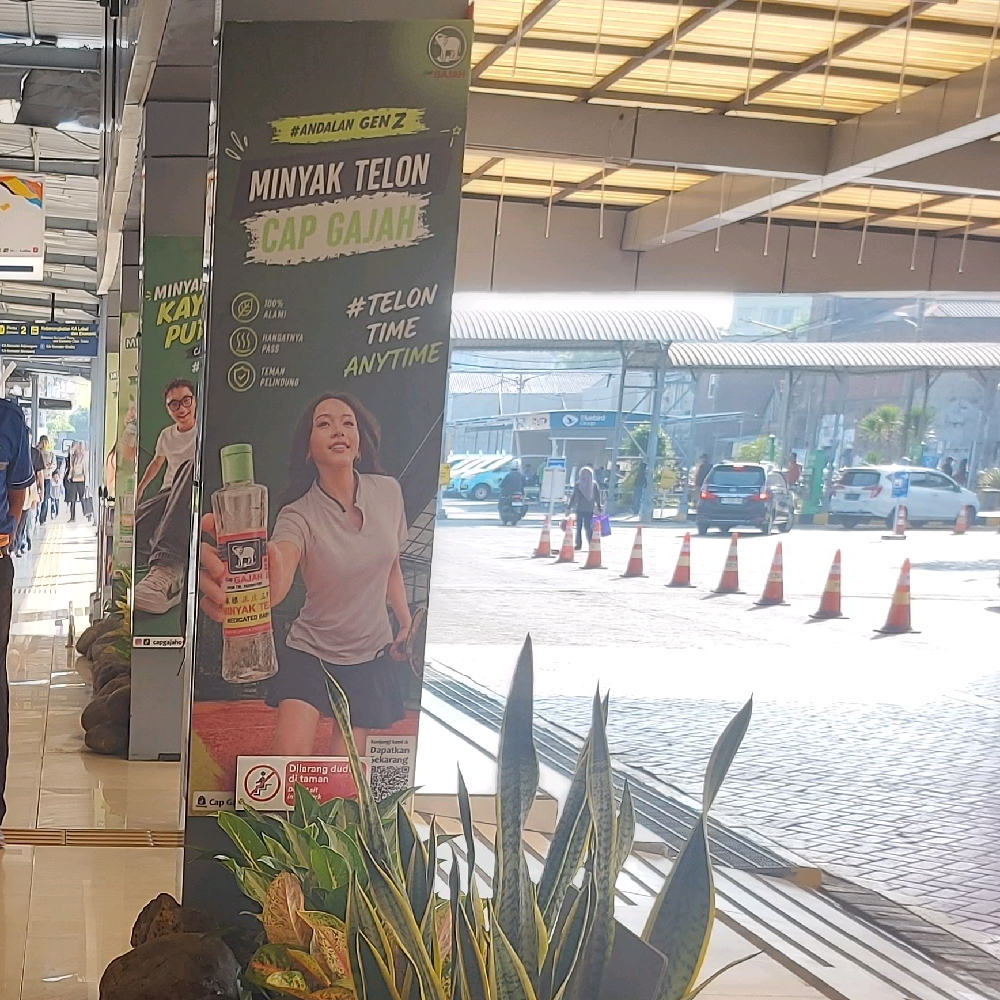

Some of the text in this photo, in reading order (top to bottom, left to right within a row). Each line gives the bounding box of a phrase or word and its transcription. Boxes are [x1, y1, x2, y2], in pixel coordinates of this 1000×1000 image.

[290, 112, 407, 138] #ANDALAN GEN Z
[249, 153, 431, 202] MINYAK TELON
[261, 204, 417, 254] CAP GAJAH
[263, 299, 284, 308] 100%
[346, 283, 438, 318] #TELON
[263, 309, 287, 319] ALAMI
[20, 325, 27, 335] 2
[366, 316, 421, 345] TIME
[343, 341, 444, 378] ANYTIME
[234, 573, 262, 584] GAJAH
[370, 746, 410, 756] Dapatkan
[289, 764, 328, 775] Dilarang
[288, 774, 329, 783] di taman
[209, 799, 225, 808] Cap
